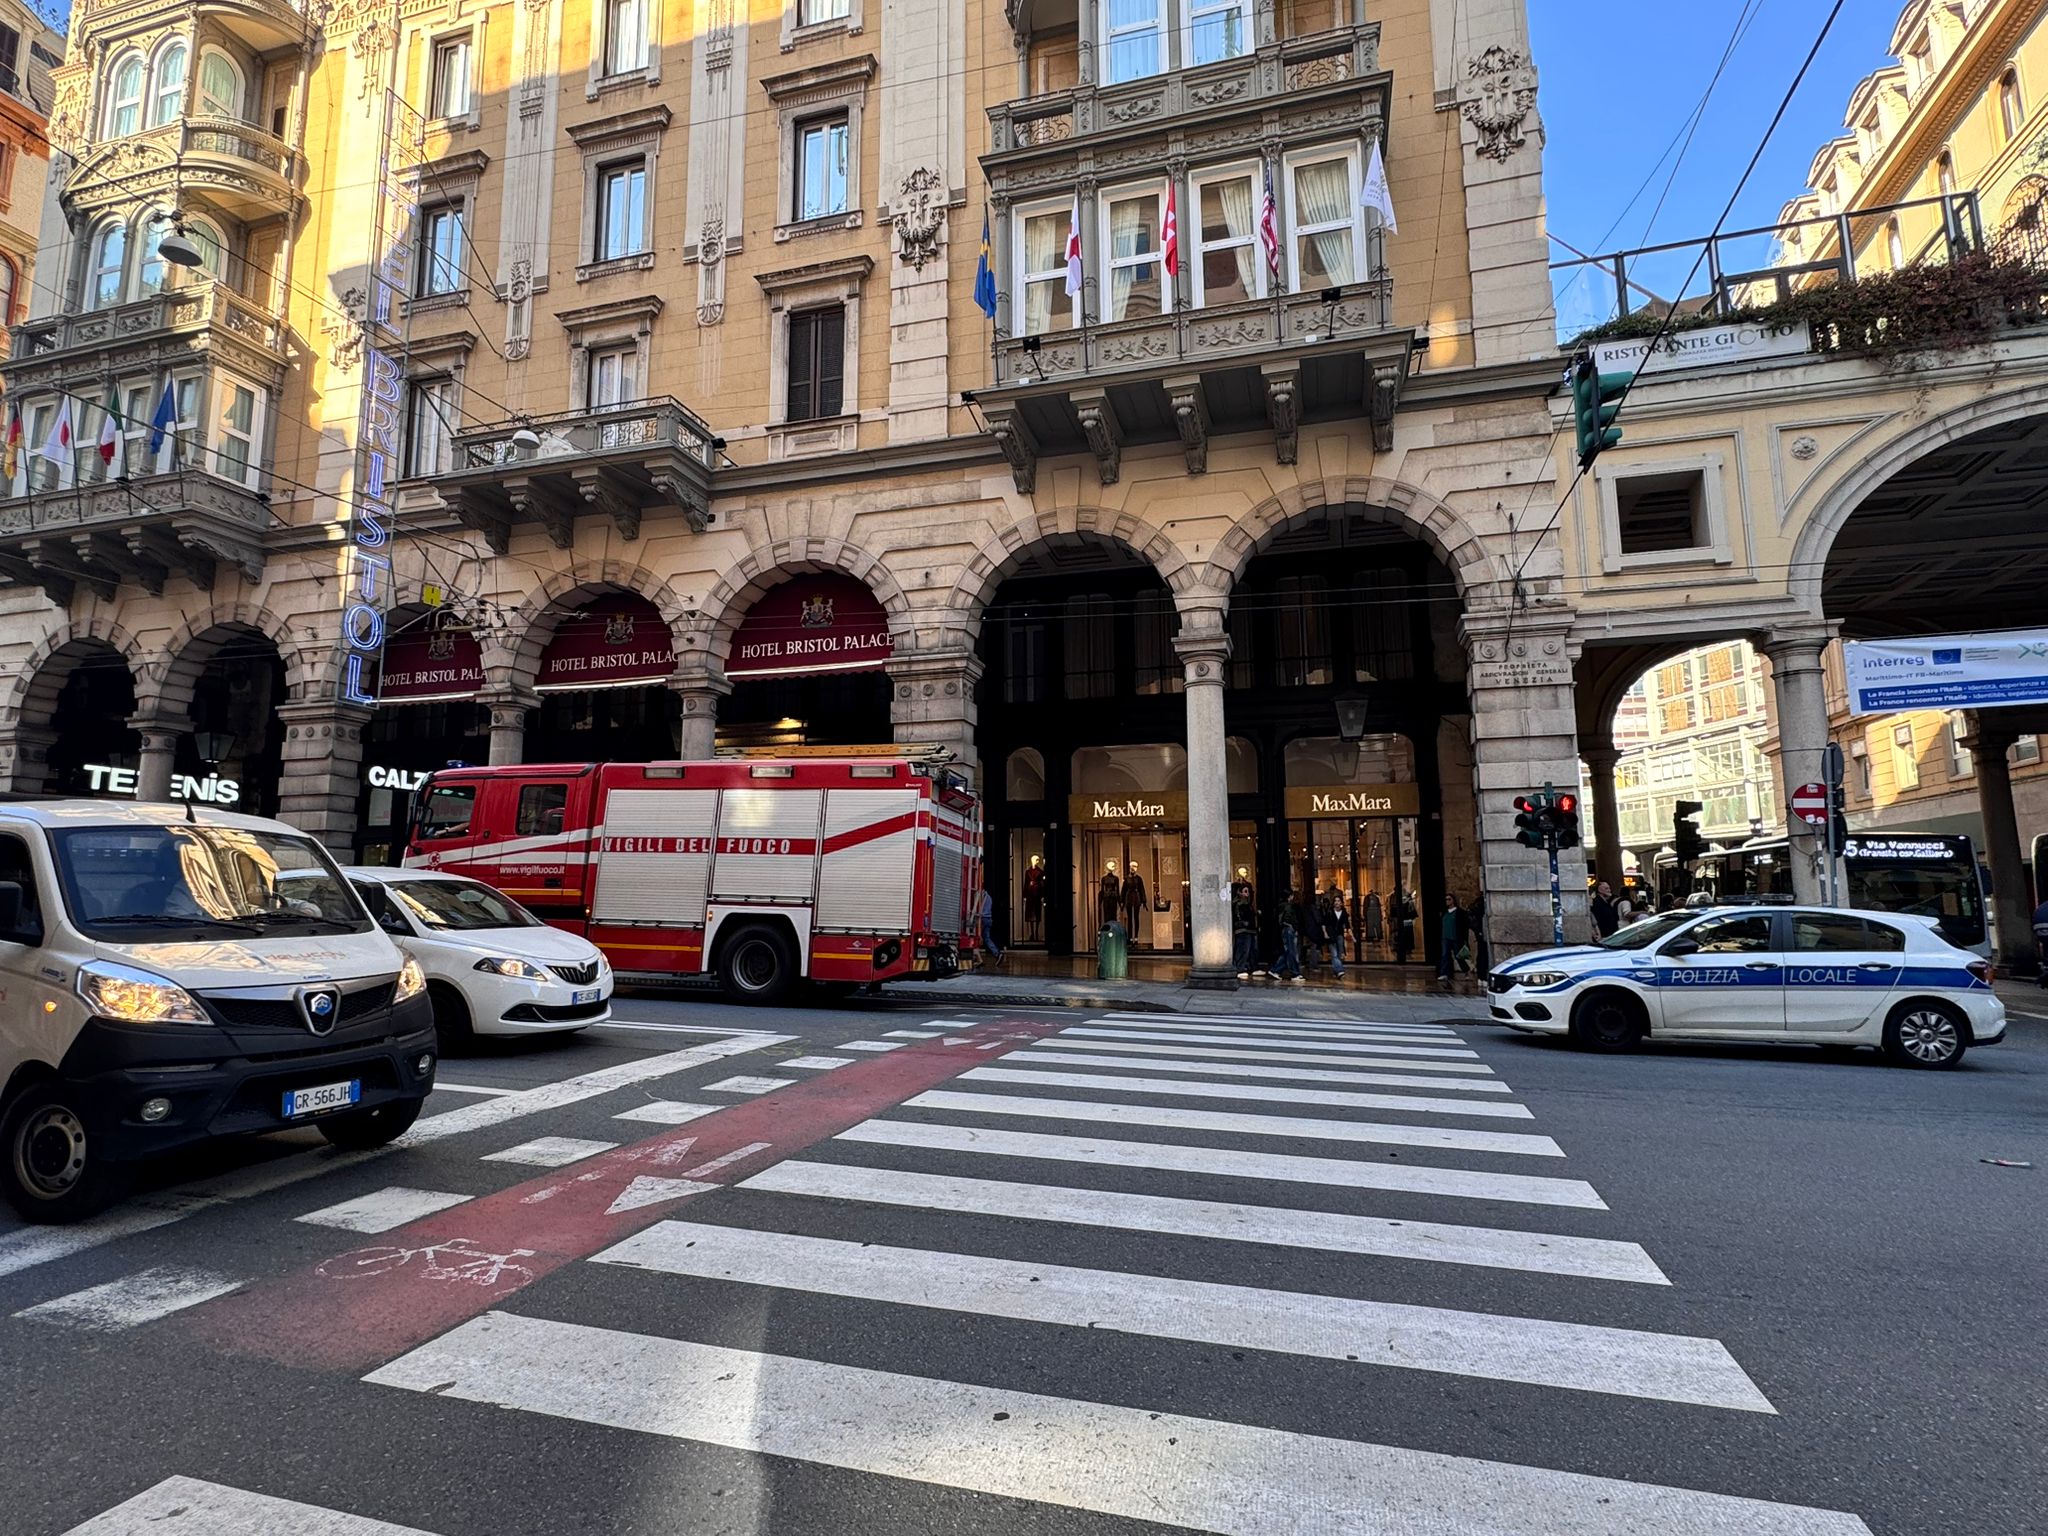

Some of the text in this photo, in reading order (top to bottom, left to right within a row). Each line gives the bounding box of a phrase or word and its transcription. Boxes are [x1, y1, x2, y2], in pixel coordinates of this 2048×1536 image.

[1603, 336, 1711, 362] RISTORANTE
[1715, 325, 1794, 346] GIOTTO
[344, 90, 423, 704] HOTEL BRISTOL
[741, 632, 894, 659] HOTEL BRISTOL PALACE
[551, 657, 587, 672] HOTEL
[591, 652, 639, 669] BRISTOL
[1863, 656, 1925, 669] Interreg
[381, 667, 488, 687] HOTEL BRISTOL PALA
[1495, 676, 1553, 685] VENEZIA
[1878, 688, 1906, 697] Francia
[1879, 698, 1905, 707] France
[1093, 800, 1165, 818] MaxMara
[1312, 793, 1392, 812] MaxMara
[604, 837, 791, 854] VIGILI DEL FUOCO
[1866, 841, 1886, 850] Via
[1888, 841, 1945, 850] Vannucci
[1671, 969, 1857, 983] POLIZIA LOCALE
